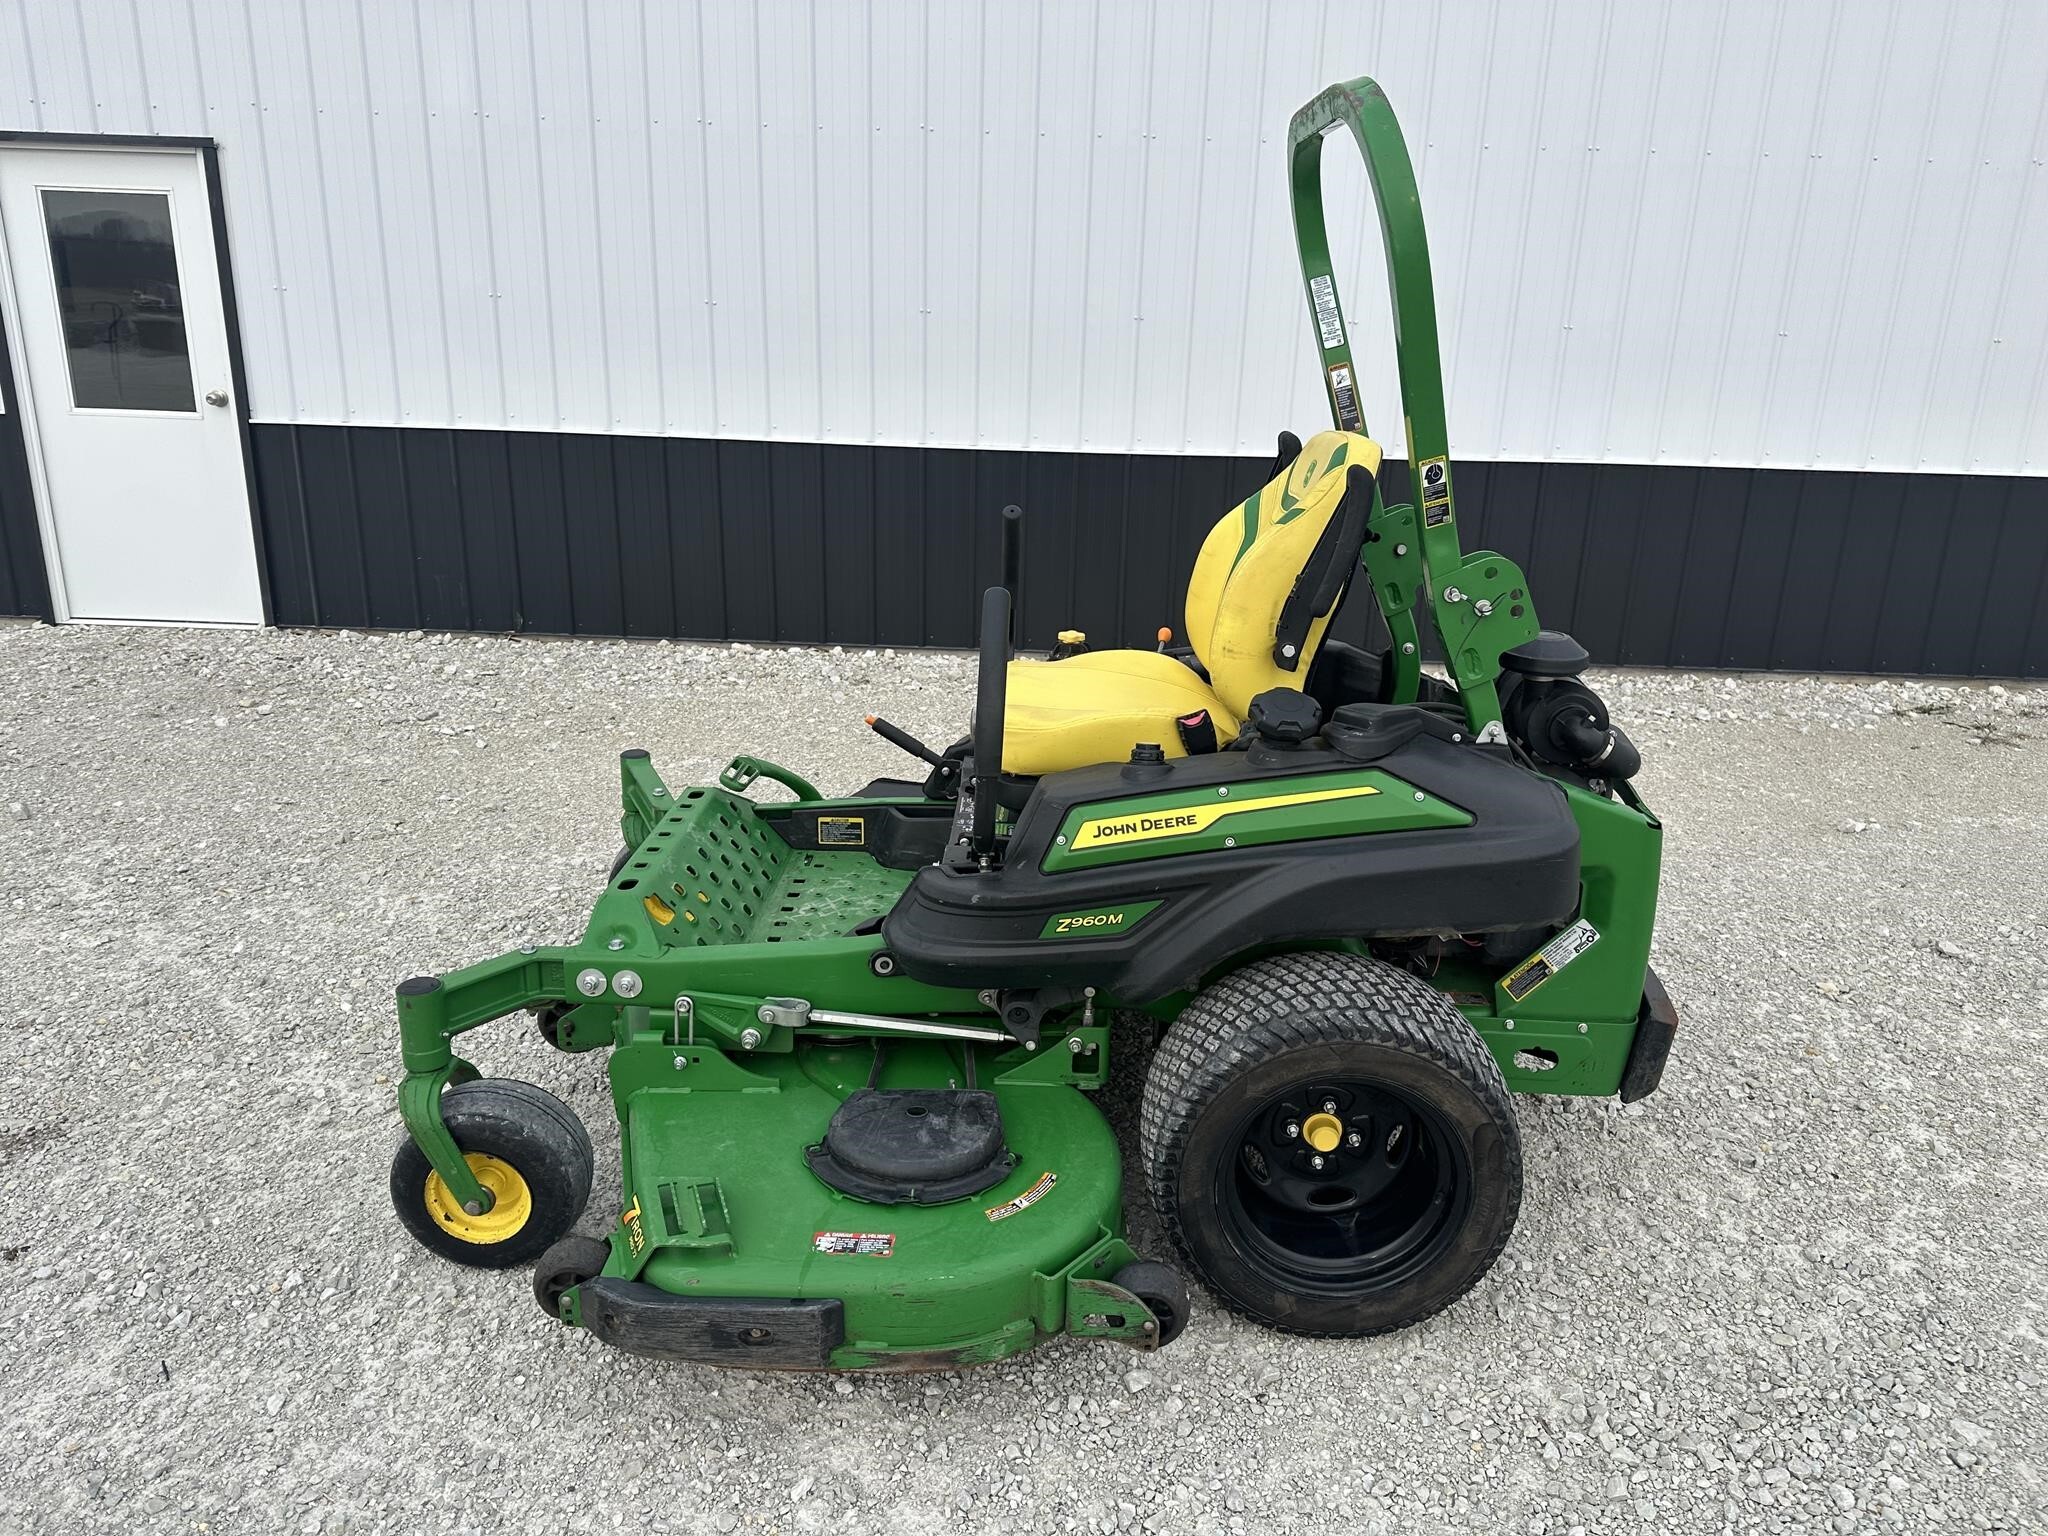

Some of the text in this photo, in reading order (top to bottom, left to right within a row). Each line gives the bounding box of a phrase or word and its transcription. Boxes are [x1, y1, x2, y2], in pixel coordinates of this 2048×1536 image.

[1093, 815, 1198, 839] JOHN DEERE
[1055, 913, 1124, 933] Z960M
